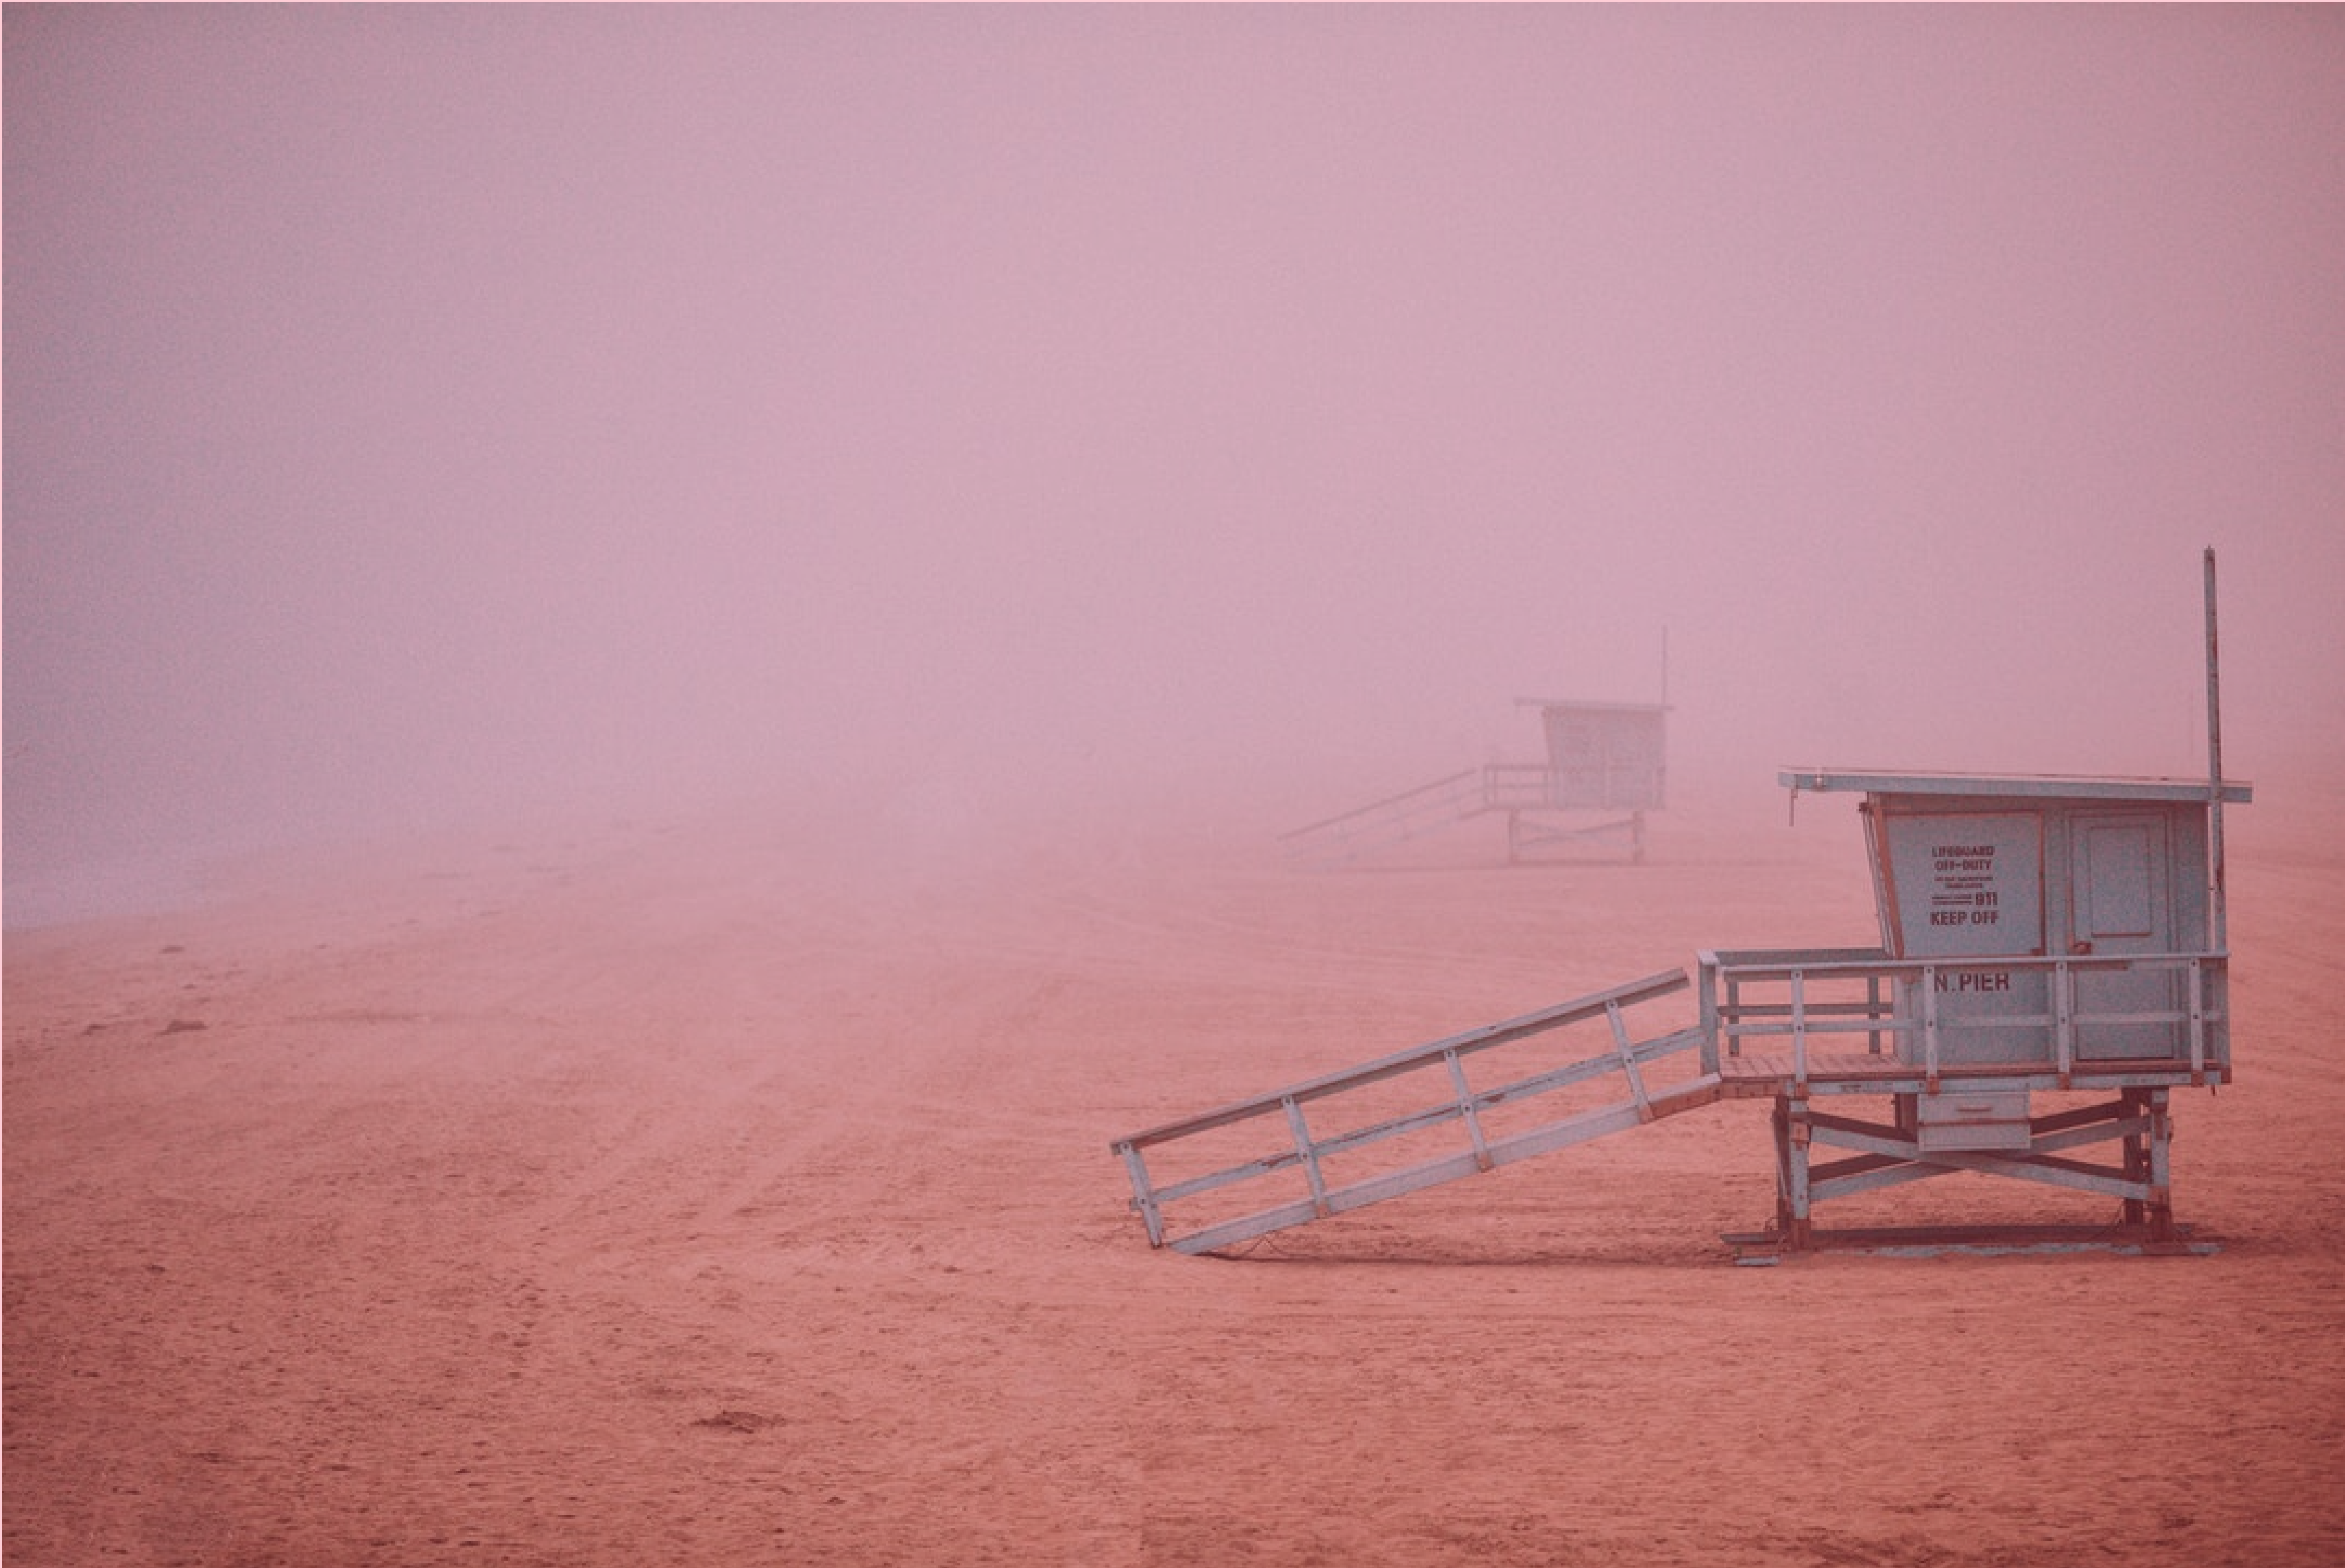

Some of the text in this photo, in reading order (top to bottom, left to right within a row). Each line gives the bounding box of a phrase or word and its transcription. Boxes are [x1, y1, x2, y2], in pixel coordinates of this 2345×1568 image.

[1932, 846, 1995, 857] LIFEGUARD
[1934, 860, 1992, 871] OFF-DUTY
[1976, 892, 1998, 906] 911
[1930, 910, 2000, 925] KEEP OFF
[1959, 973, 2009, 991] PIER
